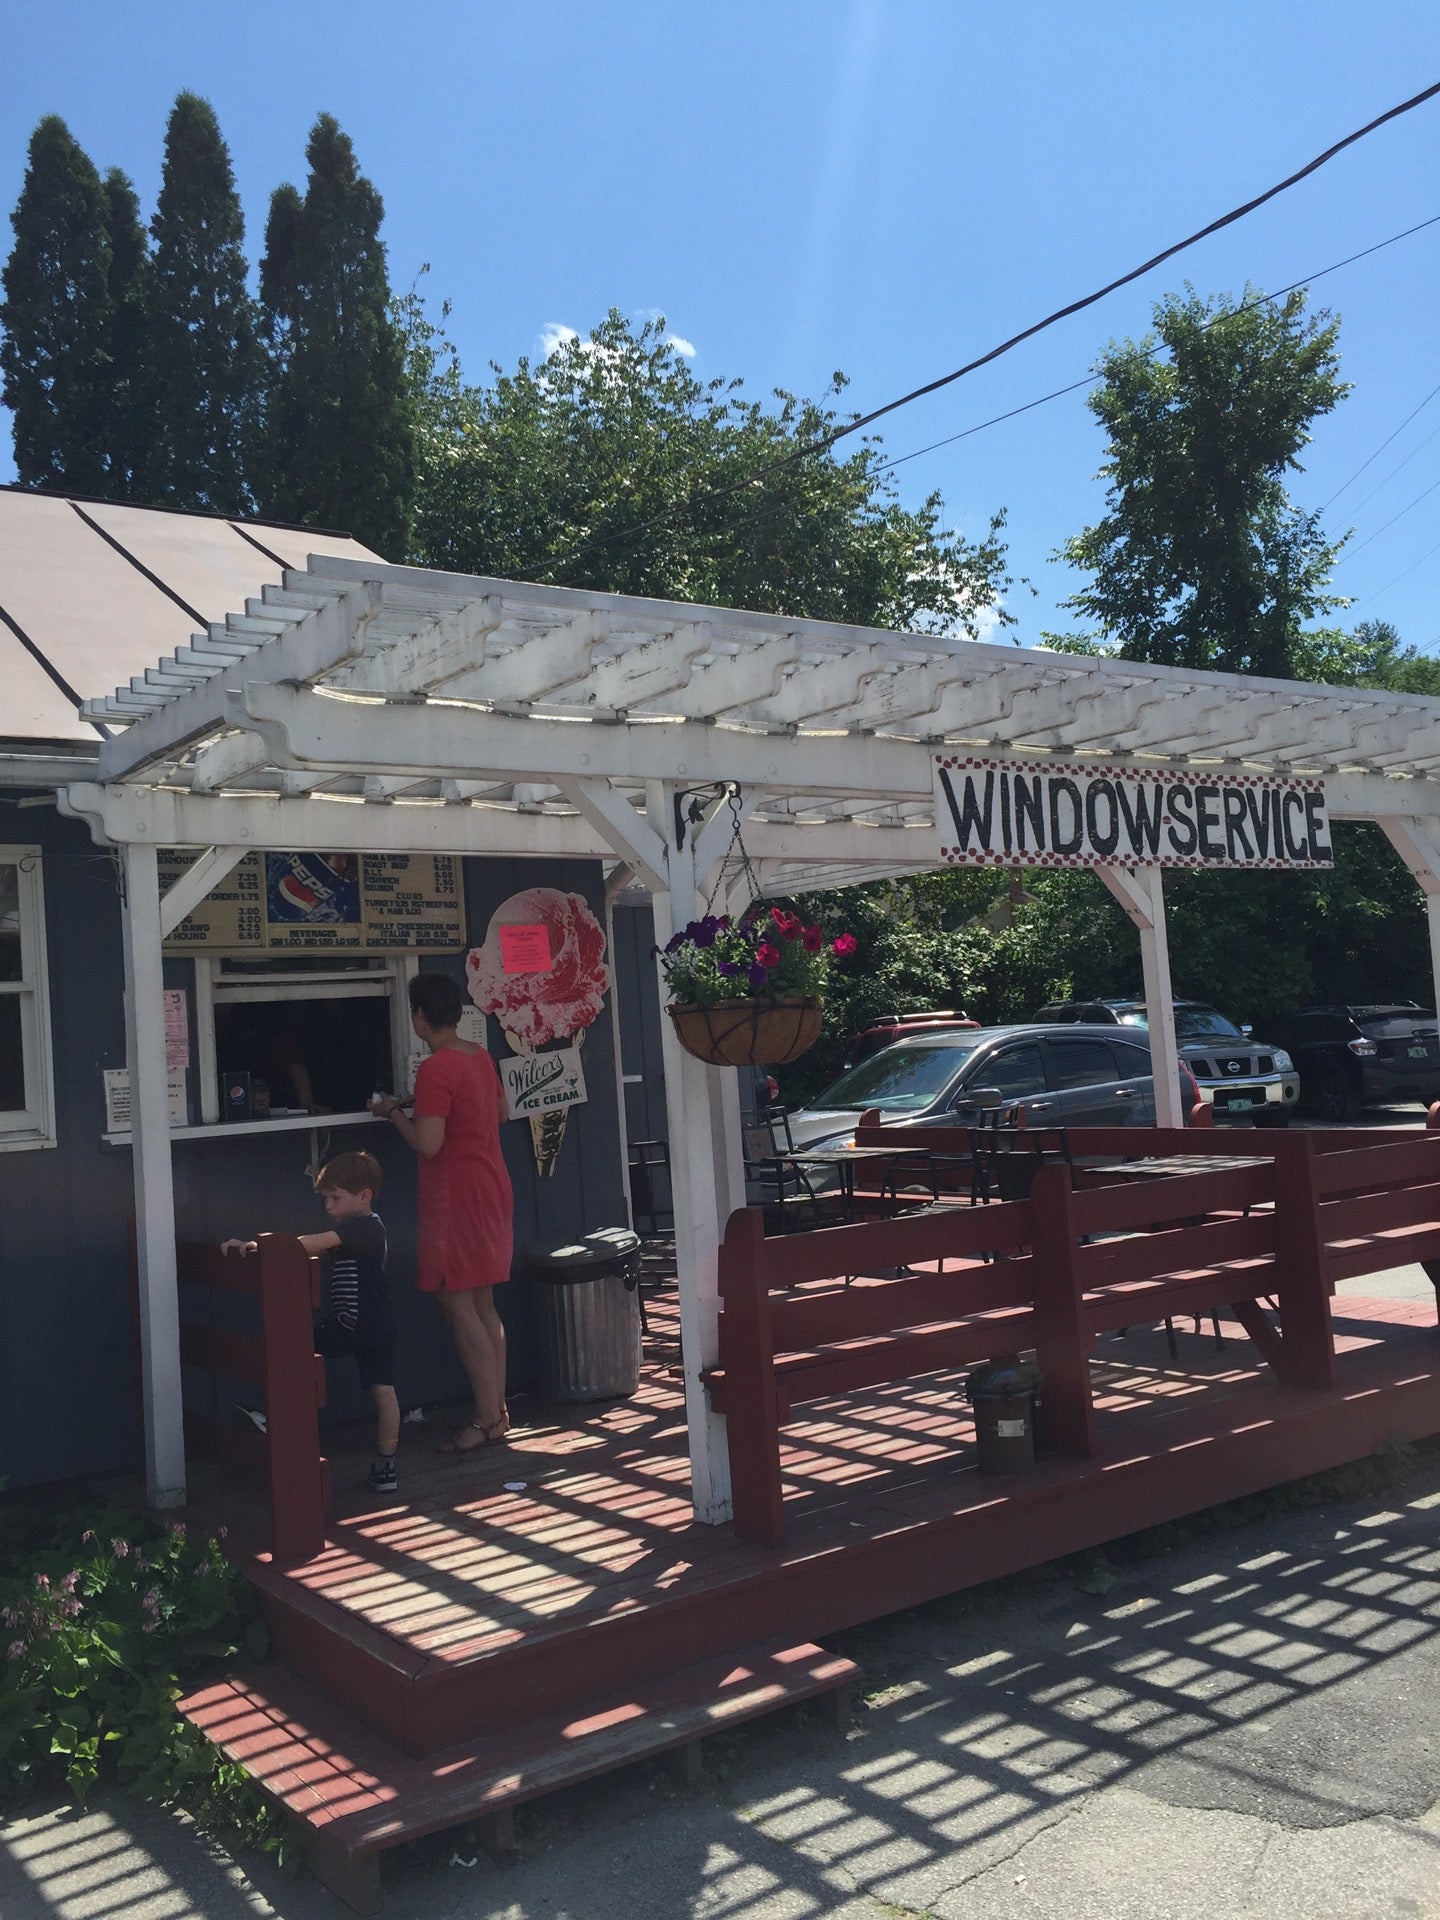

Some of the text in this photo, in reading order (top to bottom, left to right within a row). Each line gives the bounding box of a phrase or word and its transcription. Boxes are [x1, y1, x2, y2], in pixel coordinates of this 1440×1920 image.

[363, 861, 387, 869] ROAST
[364, 884, 394, 892] REUBEN
[211, 893, 239, 901] ORDER
[396, 892, 423, 900] CLUBS
[364, 899, 394, 907] TURKEY
[238, 907, 259, 915] 3.00
[182, 924, 210, 932] DAWG
[174, 932, 207, 940] HOUND
[523, 1098, 540, 1110] ICE
